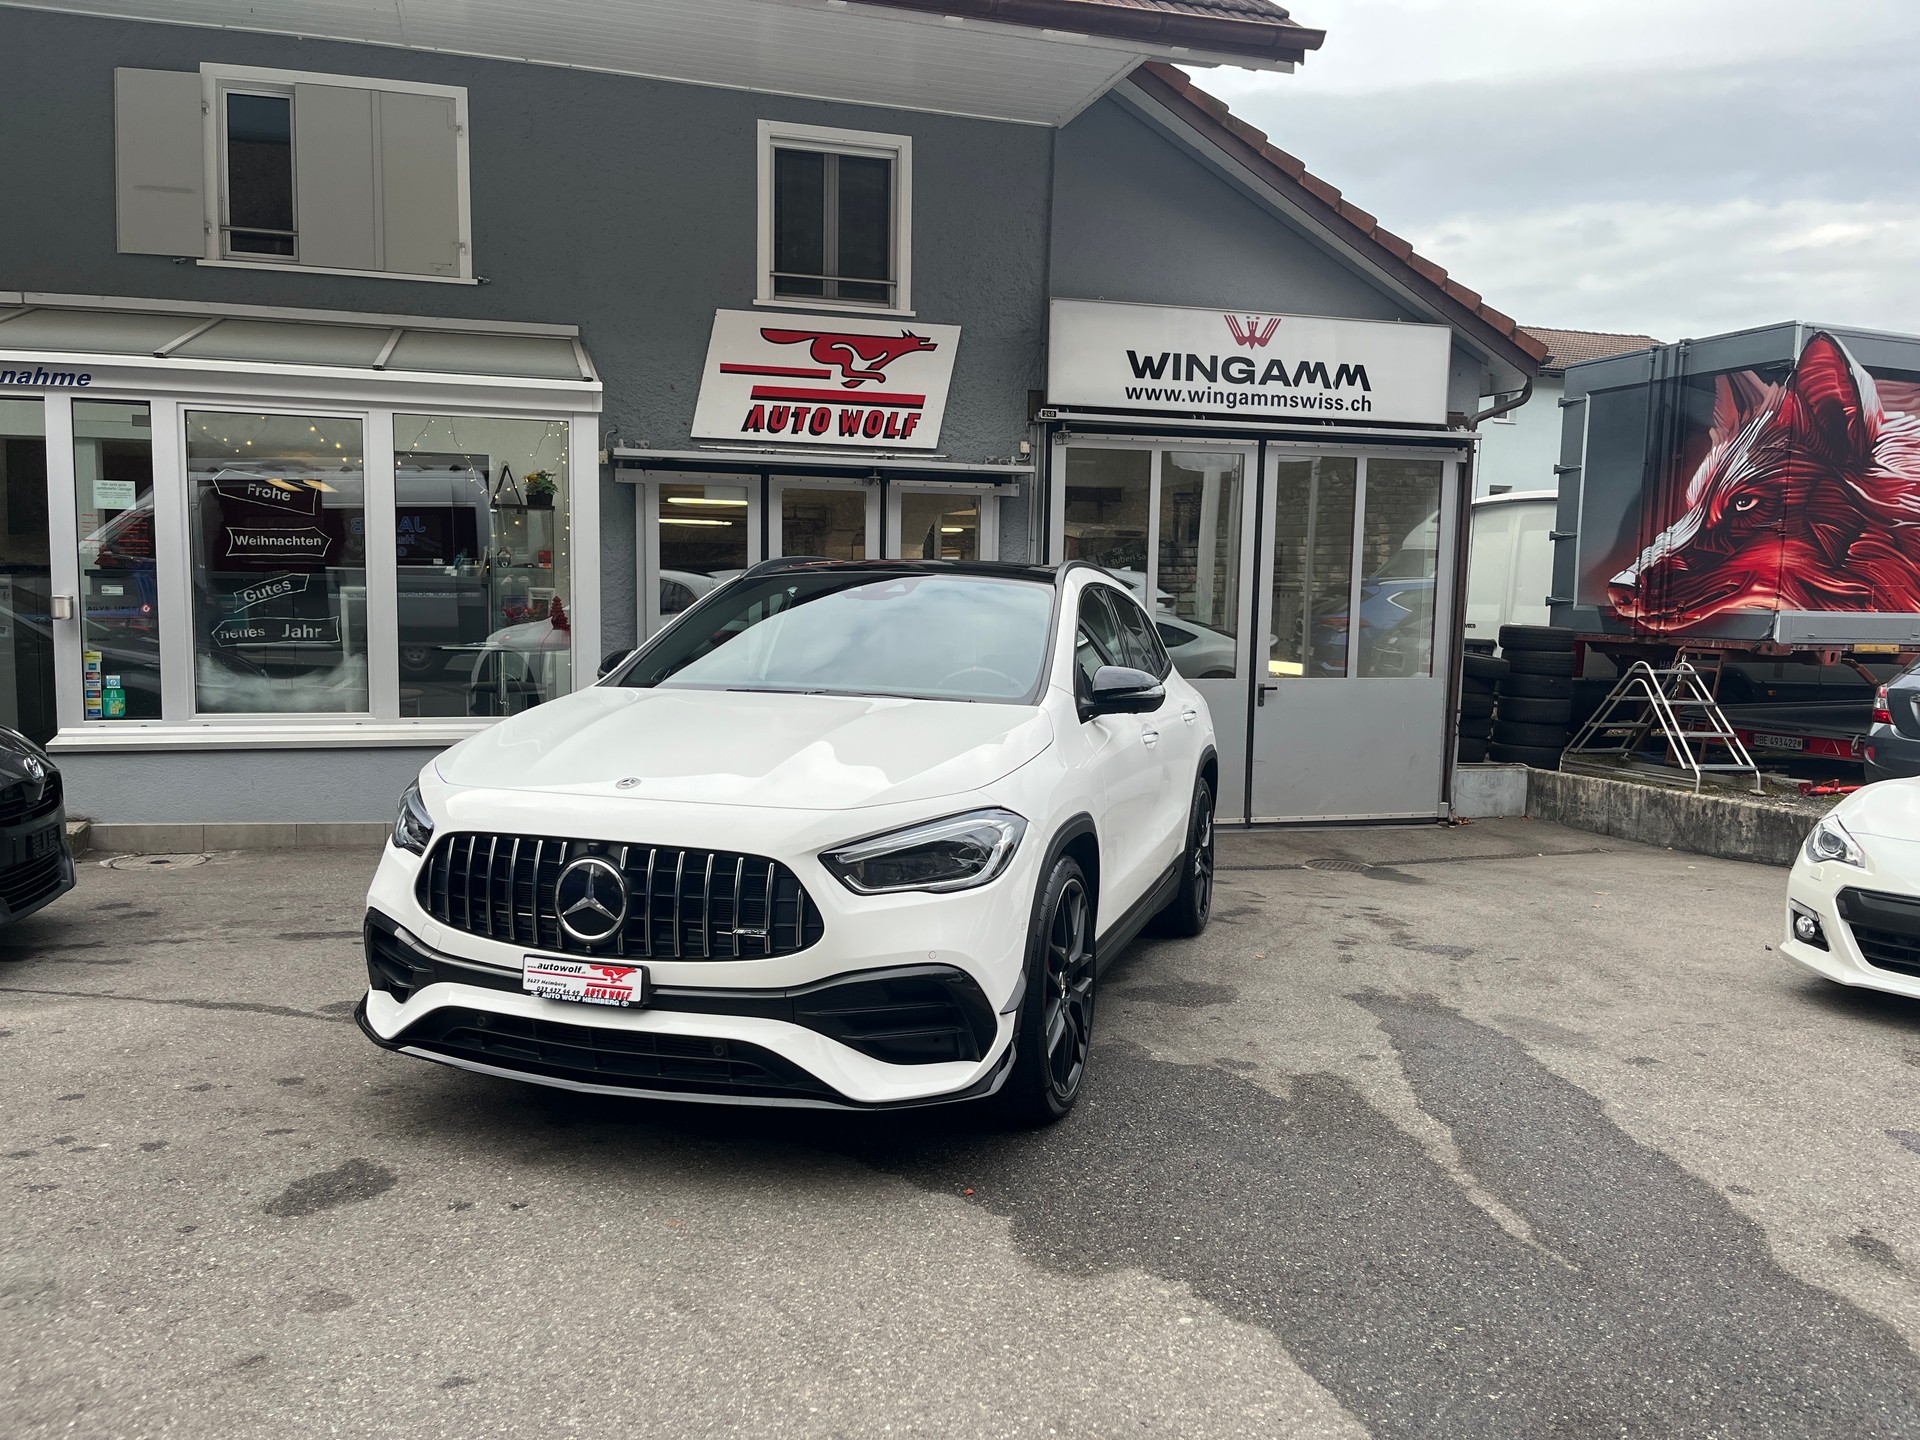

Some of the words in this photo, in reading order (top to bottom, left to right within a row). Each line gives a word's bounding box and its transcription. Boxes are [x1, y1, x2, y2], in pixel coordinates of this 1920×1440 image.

[1126, 350, 1372, 392] WINGAMM
[1125, 386, 1372, 412] www.wingammswiss.ch
[741, 404, 832, 436] AUTO
[838, 409, 922, 440] WOLF
[247, 484, 291, 501] Frohe
[235, 535, 322, 546] Weihnachten
[243, 580, 292, 603] Gutes
[220, 628, 266, 639] neues
[281, 624, 322, 639] Jahr
[541, 980, 568, 988] Heimberg
[541, 992, 561, 1000] AUTO
[561, 994, 581, 1002] WOLF
[582, 996, 620, 1006] HEIMBERG
[584, 987, 608, 999] AUTO
[608, 990, 633, 1001] WOLF
